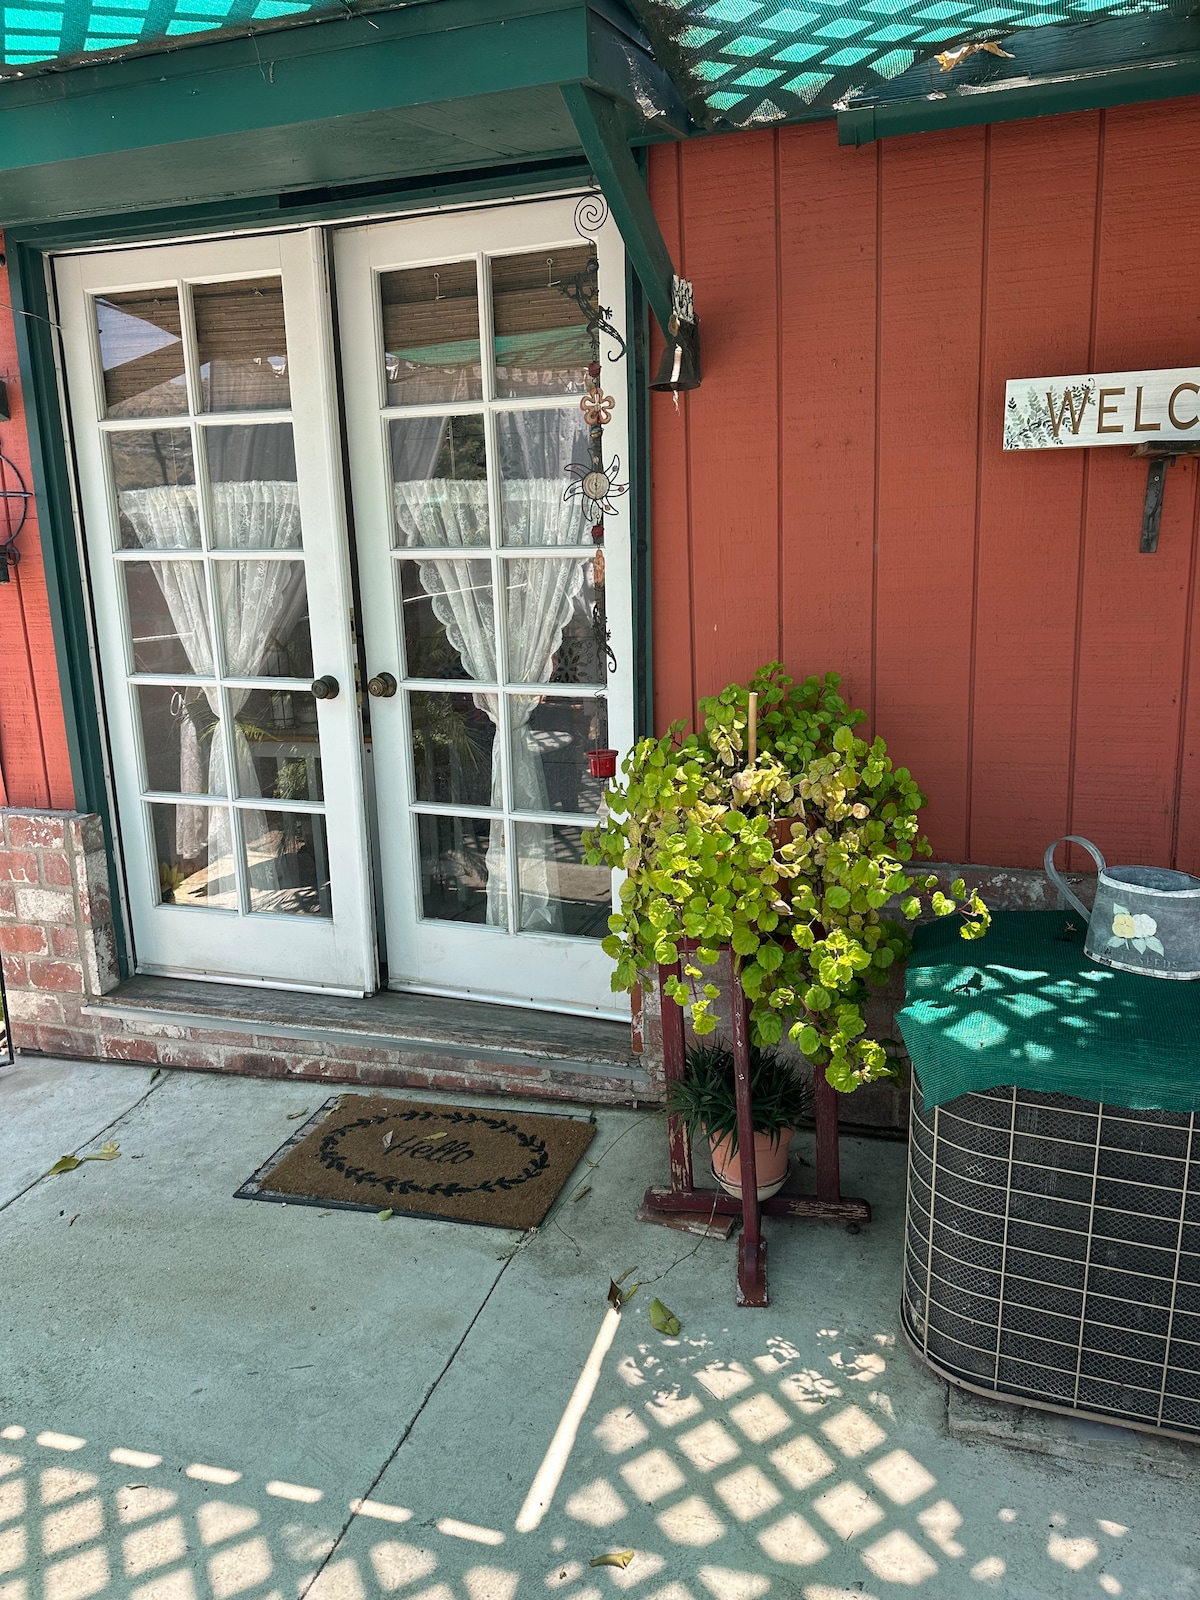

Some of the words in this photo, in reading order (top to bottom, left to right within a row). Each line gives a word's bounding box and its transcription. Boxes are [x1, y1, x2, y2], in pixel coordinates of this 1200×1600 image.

[1045, 382, 1200, 438] WELC
[1139, 957, 1179, 969] SEEDS
[382, 1134, 475, 1165] Hello
